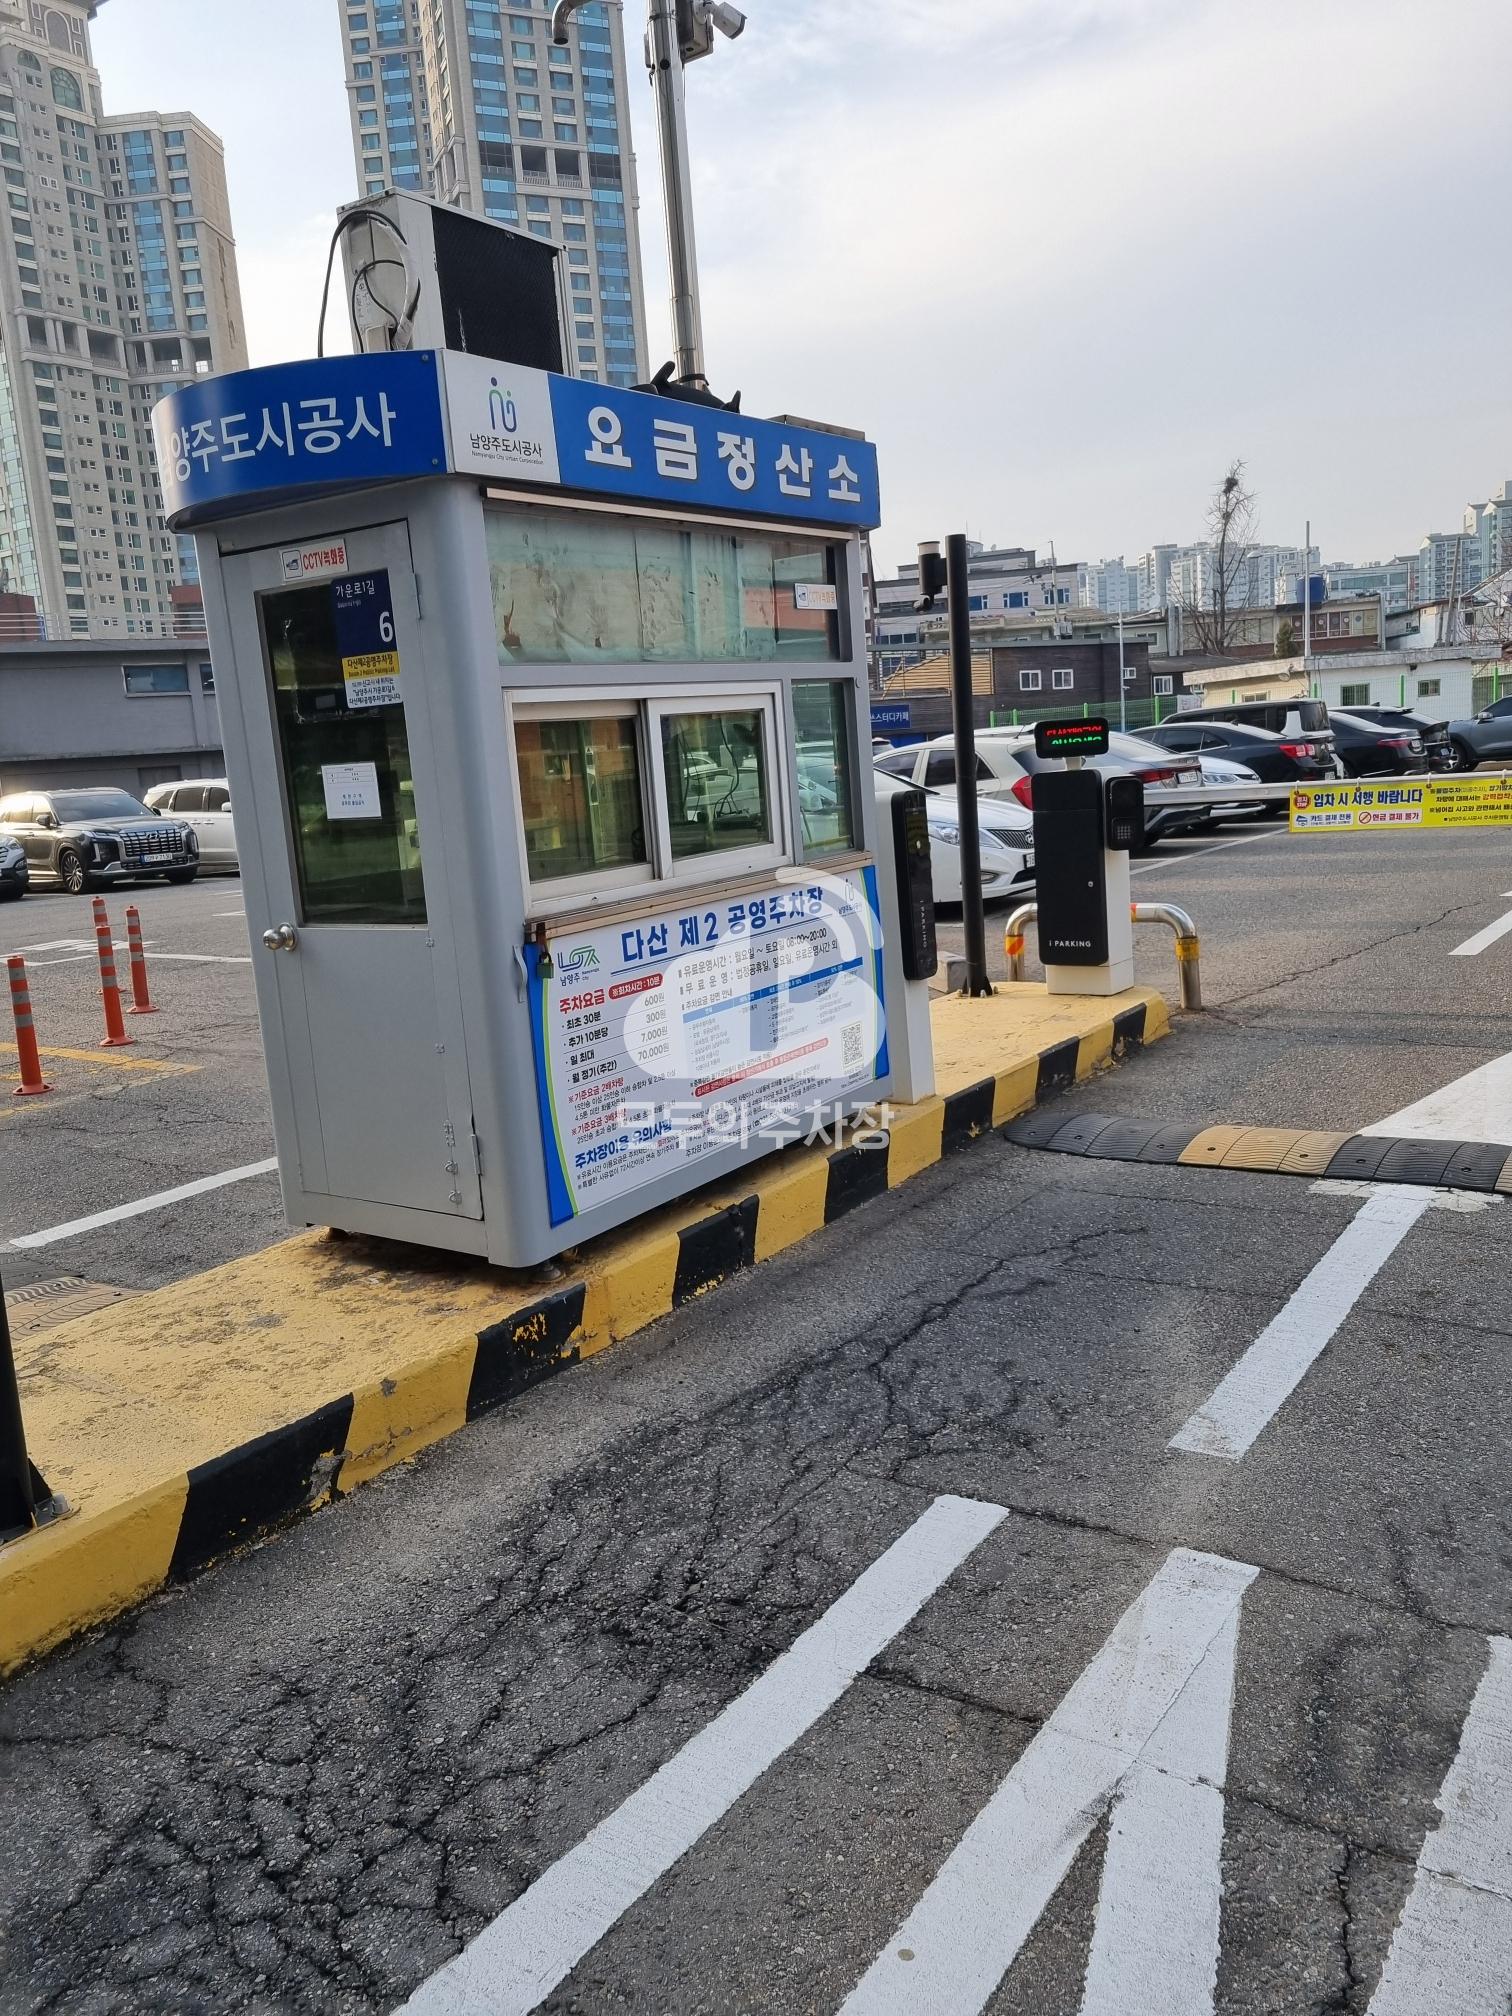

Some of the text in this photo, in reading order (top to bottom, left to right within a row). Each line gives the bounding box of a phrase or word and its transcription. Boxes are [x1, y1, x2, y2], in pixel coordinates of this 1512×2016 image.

[166, 391, 397, 483] 양주도시공사
[470, 433, 542, 458] 남양주도시공사
[302, 546, 345, 571] CCTV녹화중
[335, 580, 376, 598] 가운로1길
[379, 611, 394, 643] 6
[1313, 788, 1423, 808] 입차 시 서행 바랍니다
[621, 922, 668, 963] 다산
[727, 886, 824, 935] 공영주차장
[795, 943, 831, 961] 유료운영시간
[831, 939, 838, 950] 외
[1054, 940, 1092, 948] PARKING
[683, 955, 727, 979] 유료운영시간
[734, 947, 755, 964] 월요일
[765, 938, 785, 955] 토요일
[560, 972, 581, 987] 남양주
[646, 976, 661, 987] 10분
[560, 988, 606, 1015] 주차요금
[644, 992, 666, 1007] 600원
[685, 996, 708, 1012] 주차요금
[709, 990, 721, 1004] 감면
[721, 988, 733, 1000] 안내
[566, 1011, 602, 1030] 최초 30분
[645, 1009, 667, 1025] 300원
[568, 1027, 609, 1048] 추가 10분당
[641, 1025, 669, 1043] 7,000원
[570, 1049, 595, 1066] 일 최대
[638, 1043, 670, 1061] 70,000원
[572, 1059, 618, 1084] 월 정기(주간)
[568, 1077, 625, 1104] ※기준요금 2배차량
[571, 1117, 603, 1136] ※기준요금
[575, 1134, 630, 1169] 주차장이용
